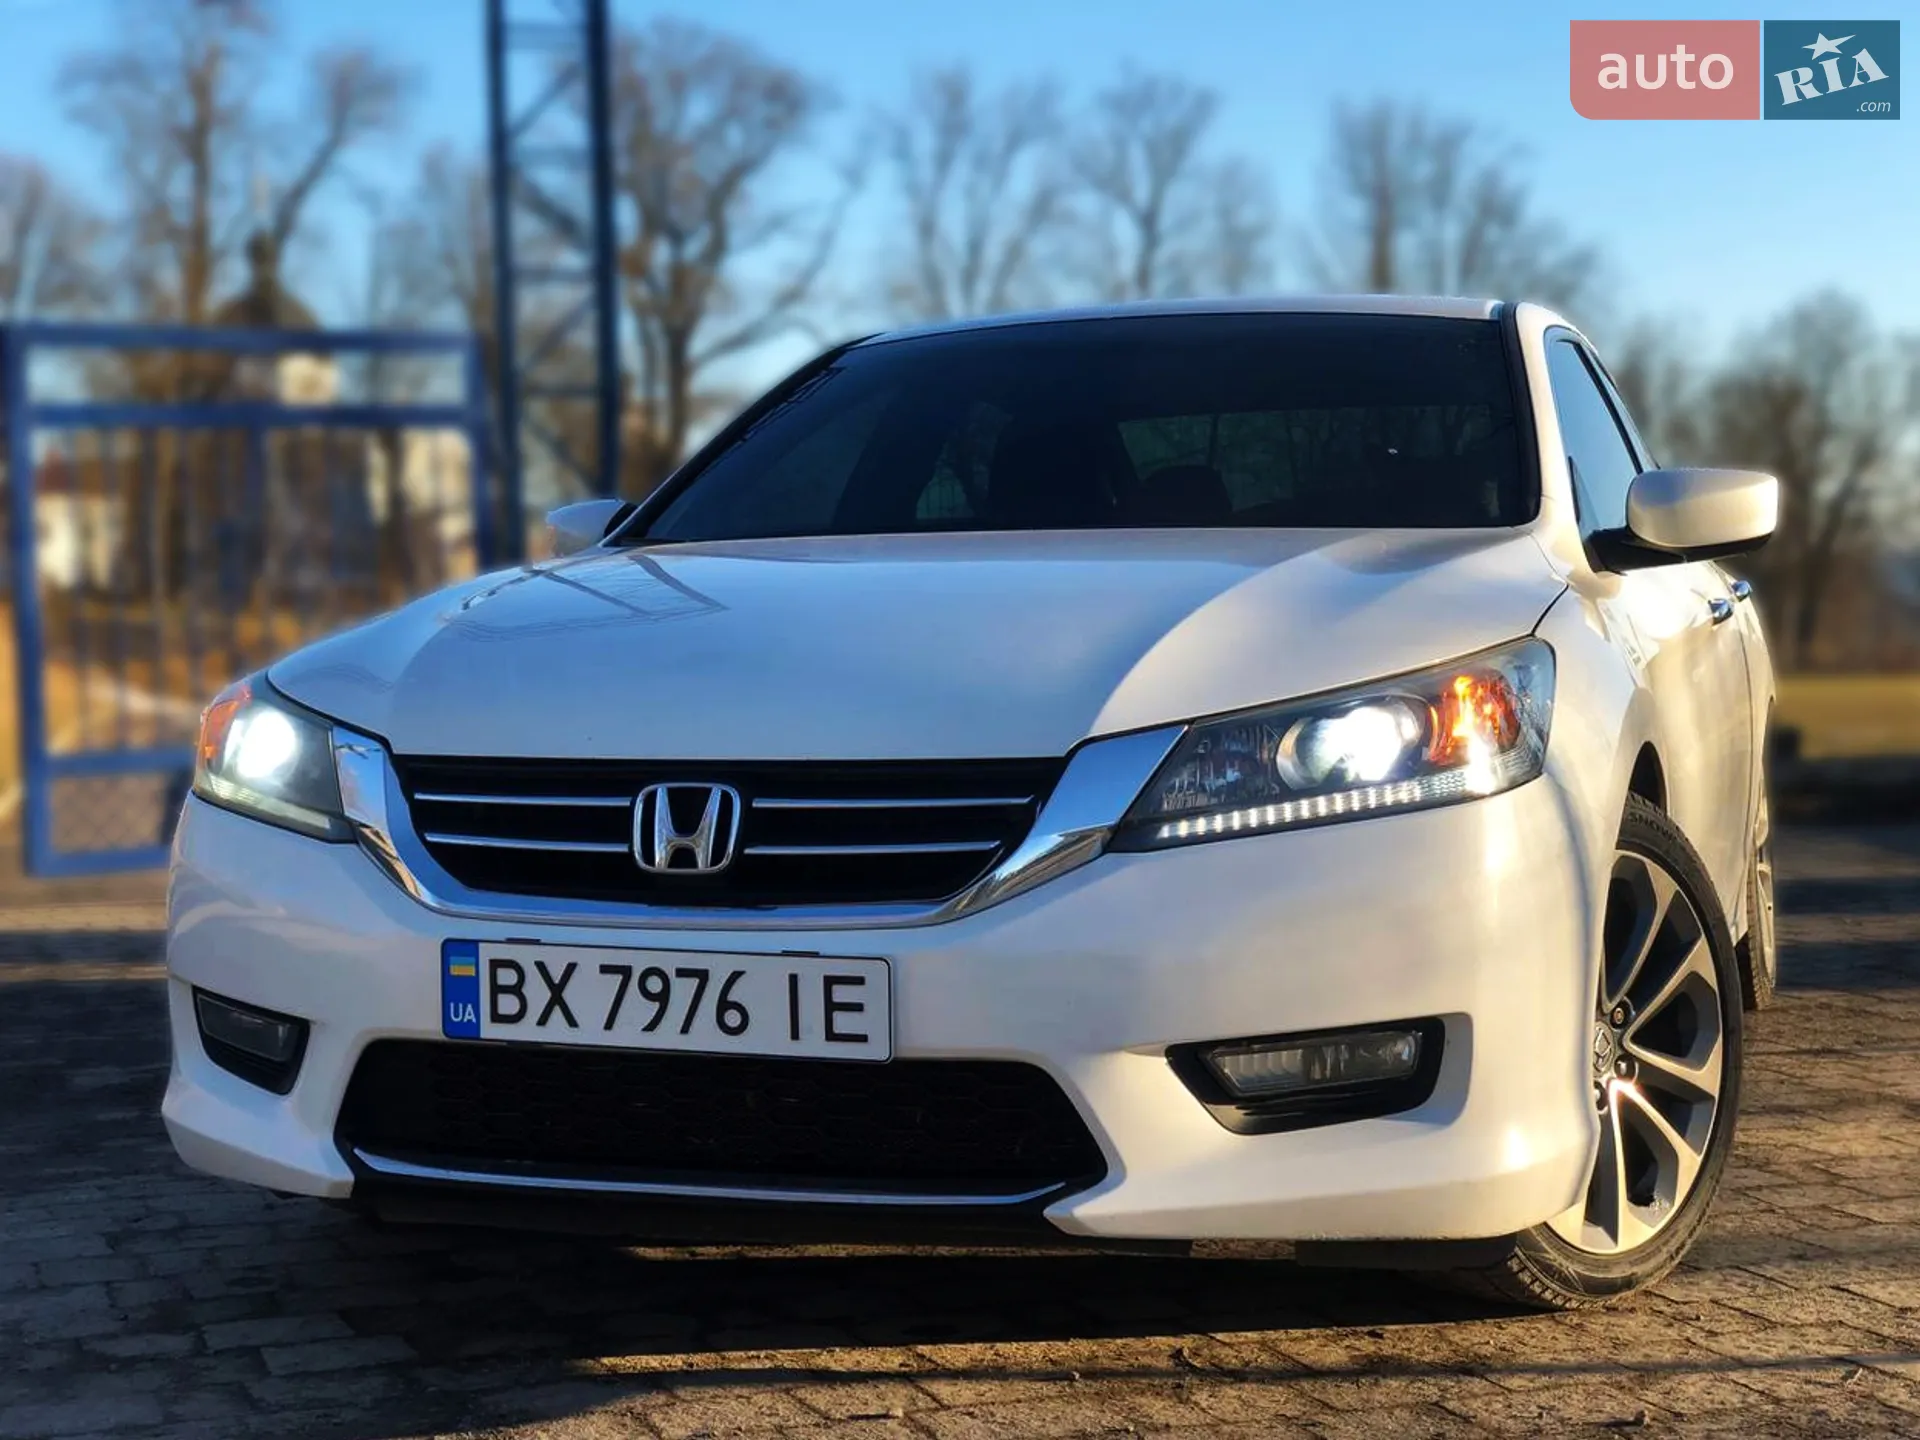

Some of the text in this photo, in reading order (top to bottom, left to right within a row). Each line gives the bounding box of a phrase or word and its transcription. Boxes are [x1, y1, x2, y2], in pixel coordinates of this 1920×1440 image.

[450, 1002, 476, 1024] UA
[488, 957, 869, 1043] BX 7976 IE
